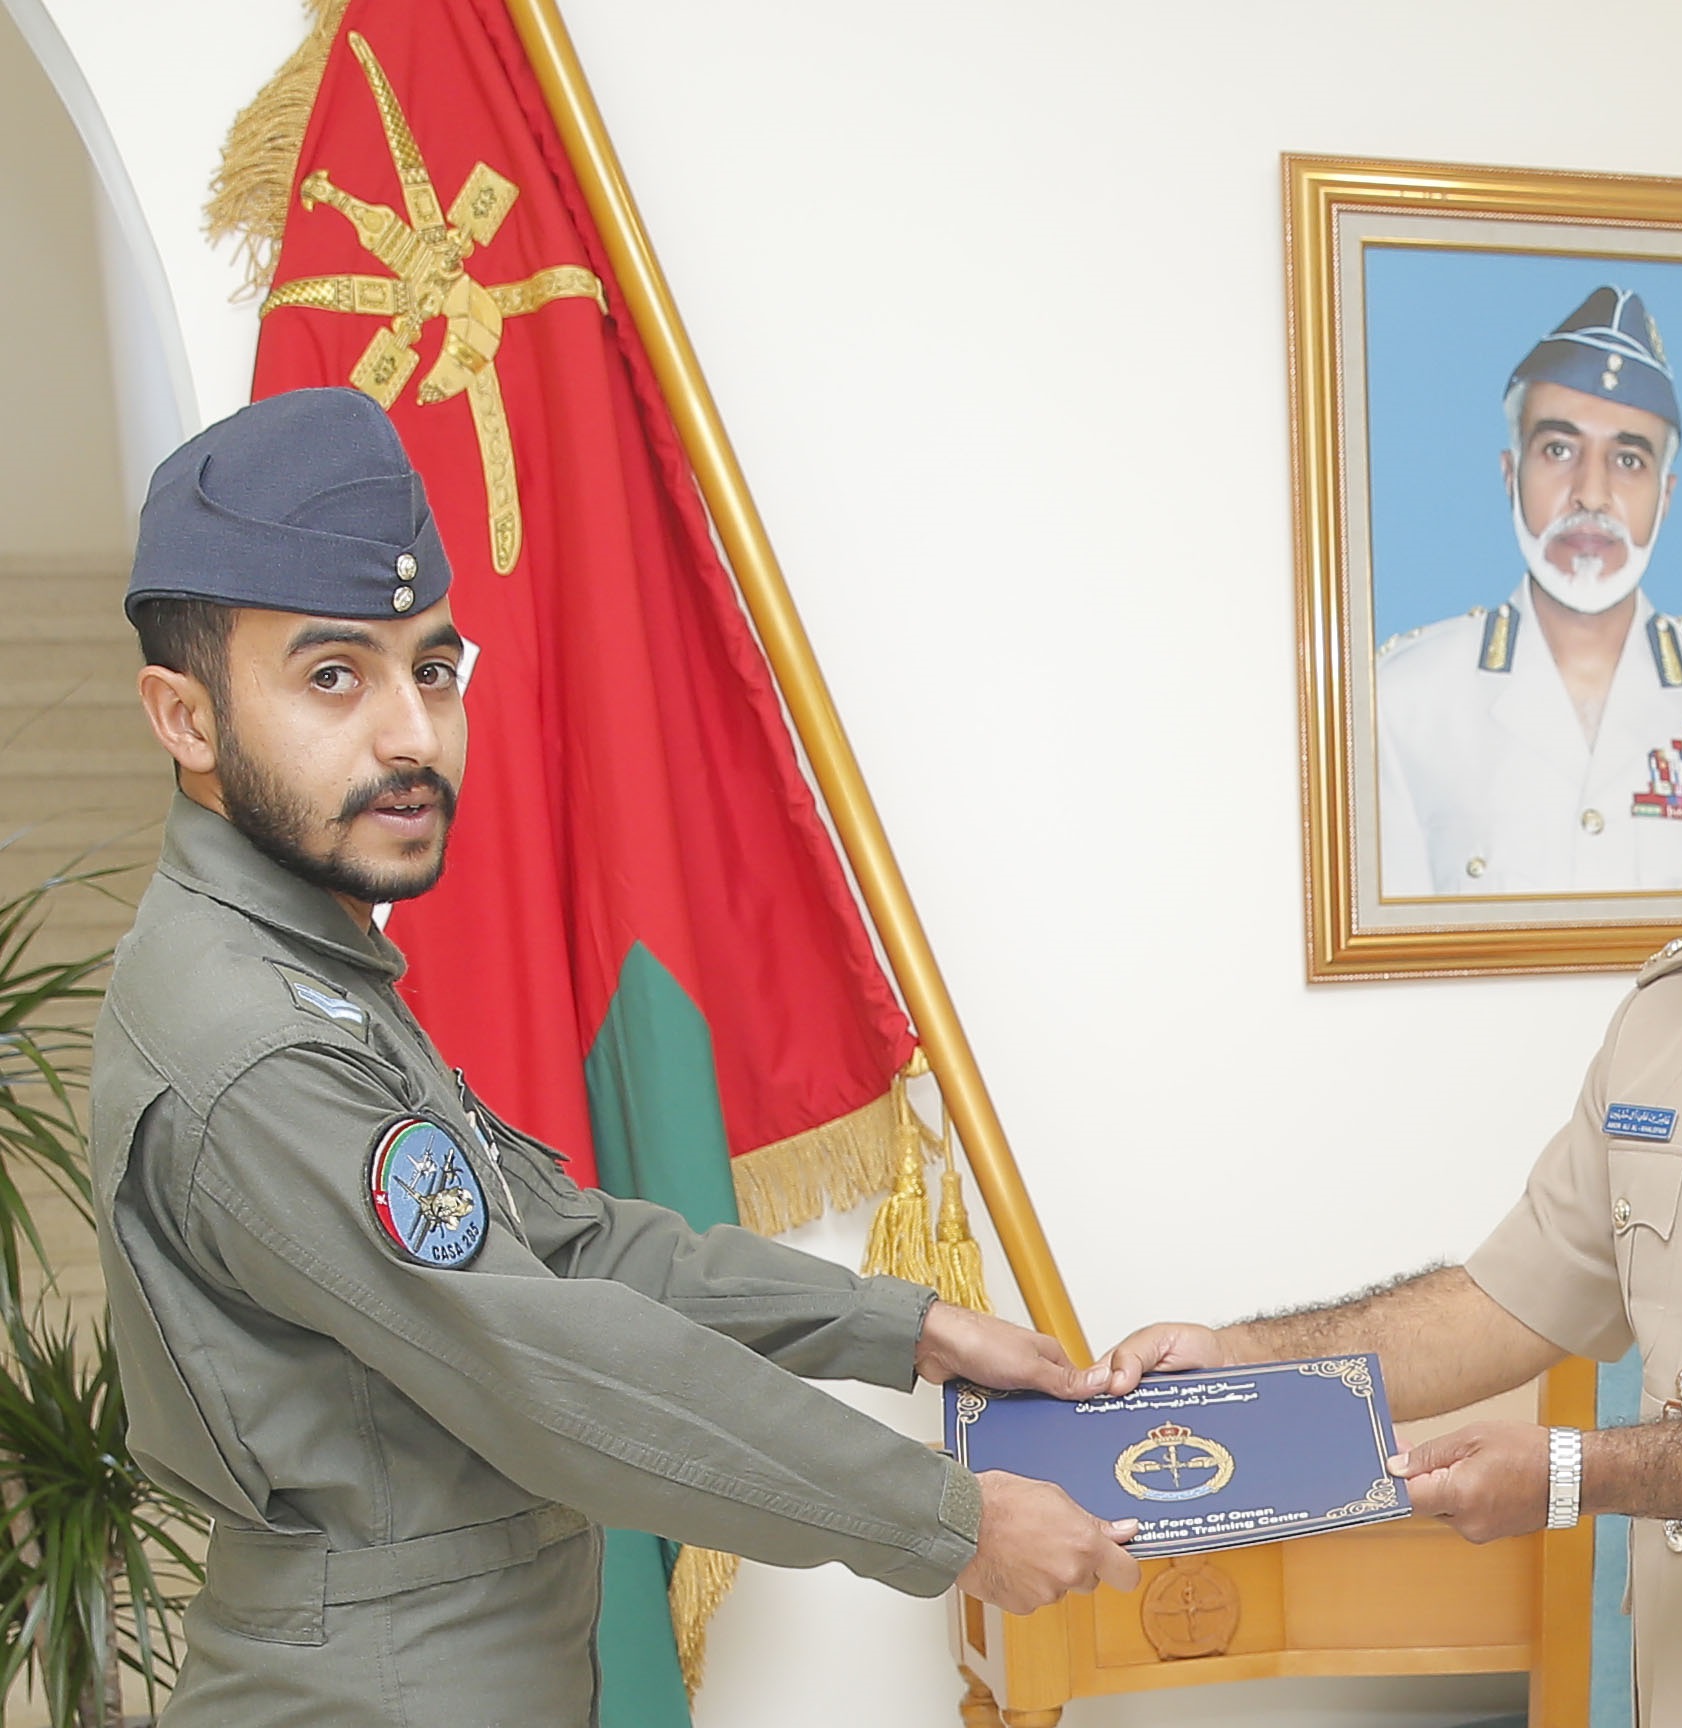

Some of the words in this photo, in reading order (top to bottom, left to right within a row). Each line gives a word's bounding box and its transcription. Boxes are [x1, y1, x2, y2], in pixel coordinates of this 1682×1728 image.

[432, 1242, 464, 1261] CASA
[1180, 1384, 1206, 1396] الجو
[1207, 1382, 1256, 1395] سلاح
[1125, 1399, 1149, 1411] طب
[1150, 1395, 1200, 1409] تدريب
[1200, 1392, 1258, 1406] مركز
[1075, 1400, 1124, 1413] الطيران
[1159, 1517, 1203, 1529] Force
[1206, 1512, 1226, 1523] Of
[1228, 1507, 1274, 1520] Oman
[1131, 1530, 1189, 1543] edicine
[1192, 1519, 1255, 1535] Training
[1258, 1511, 1309, 1525] Centre
